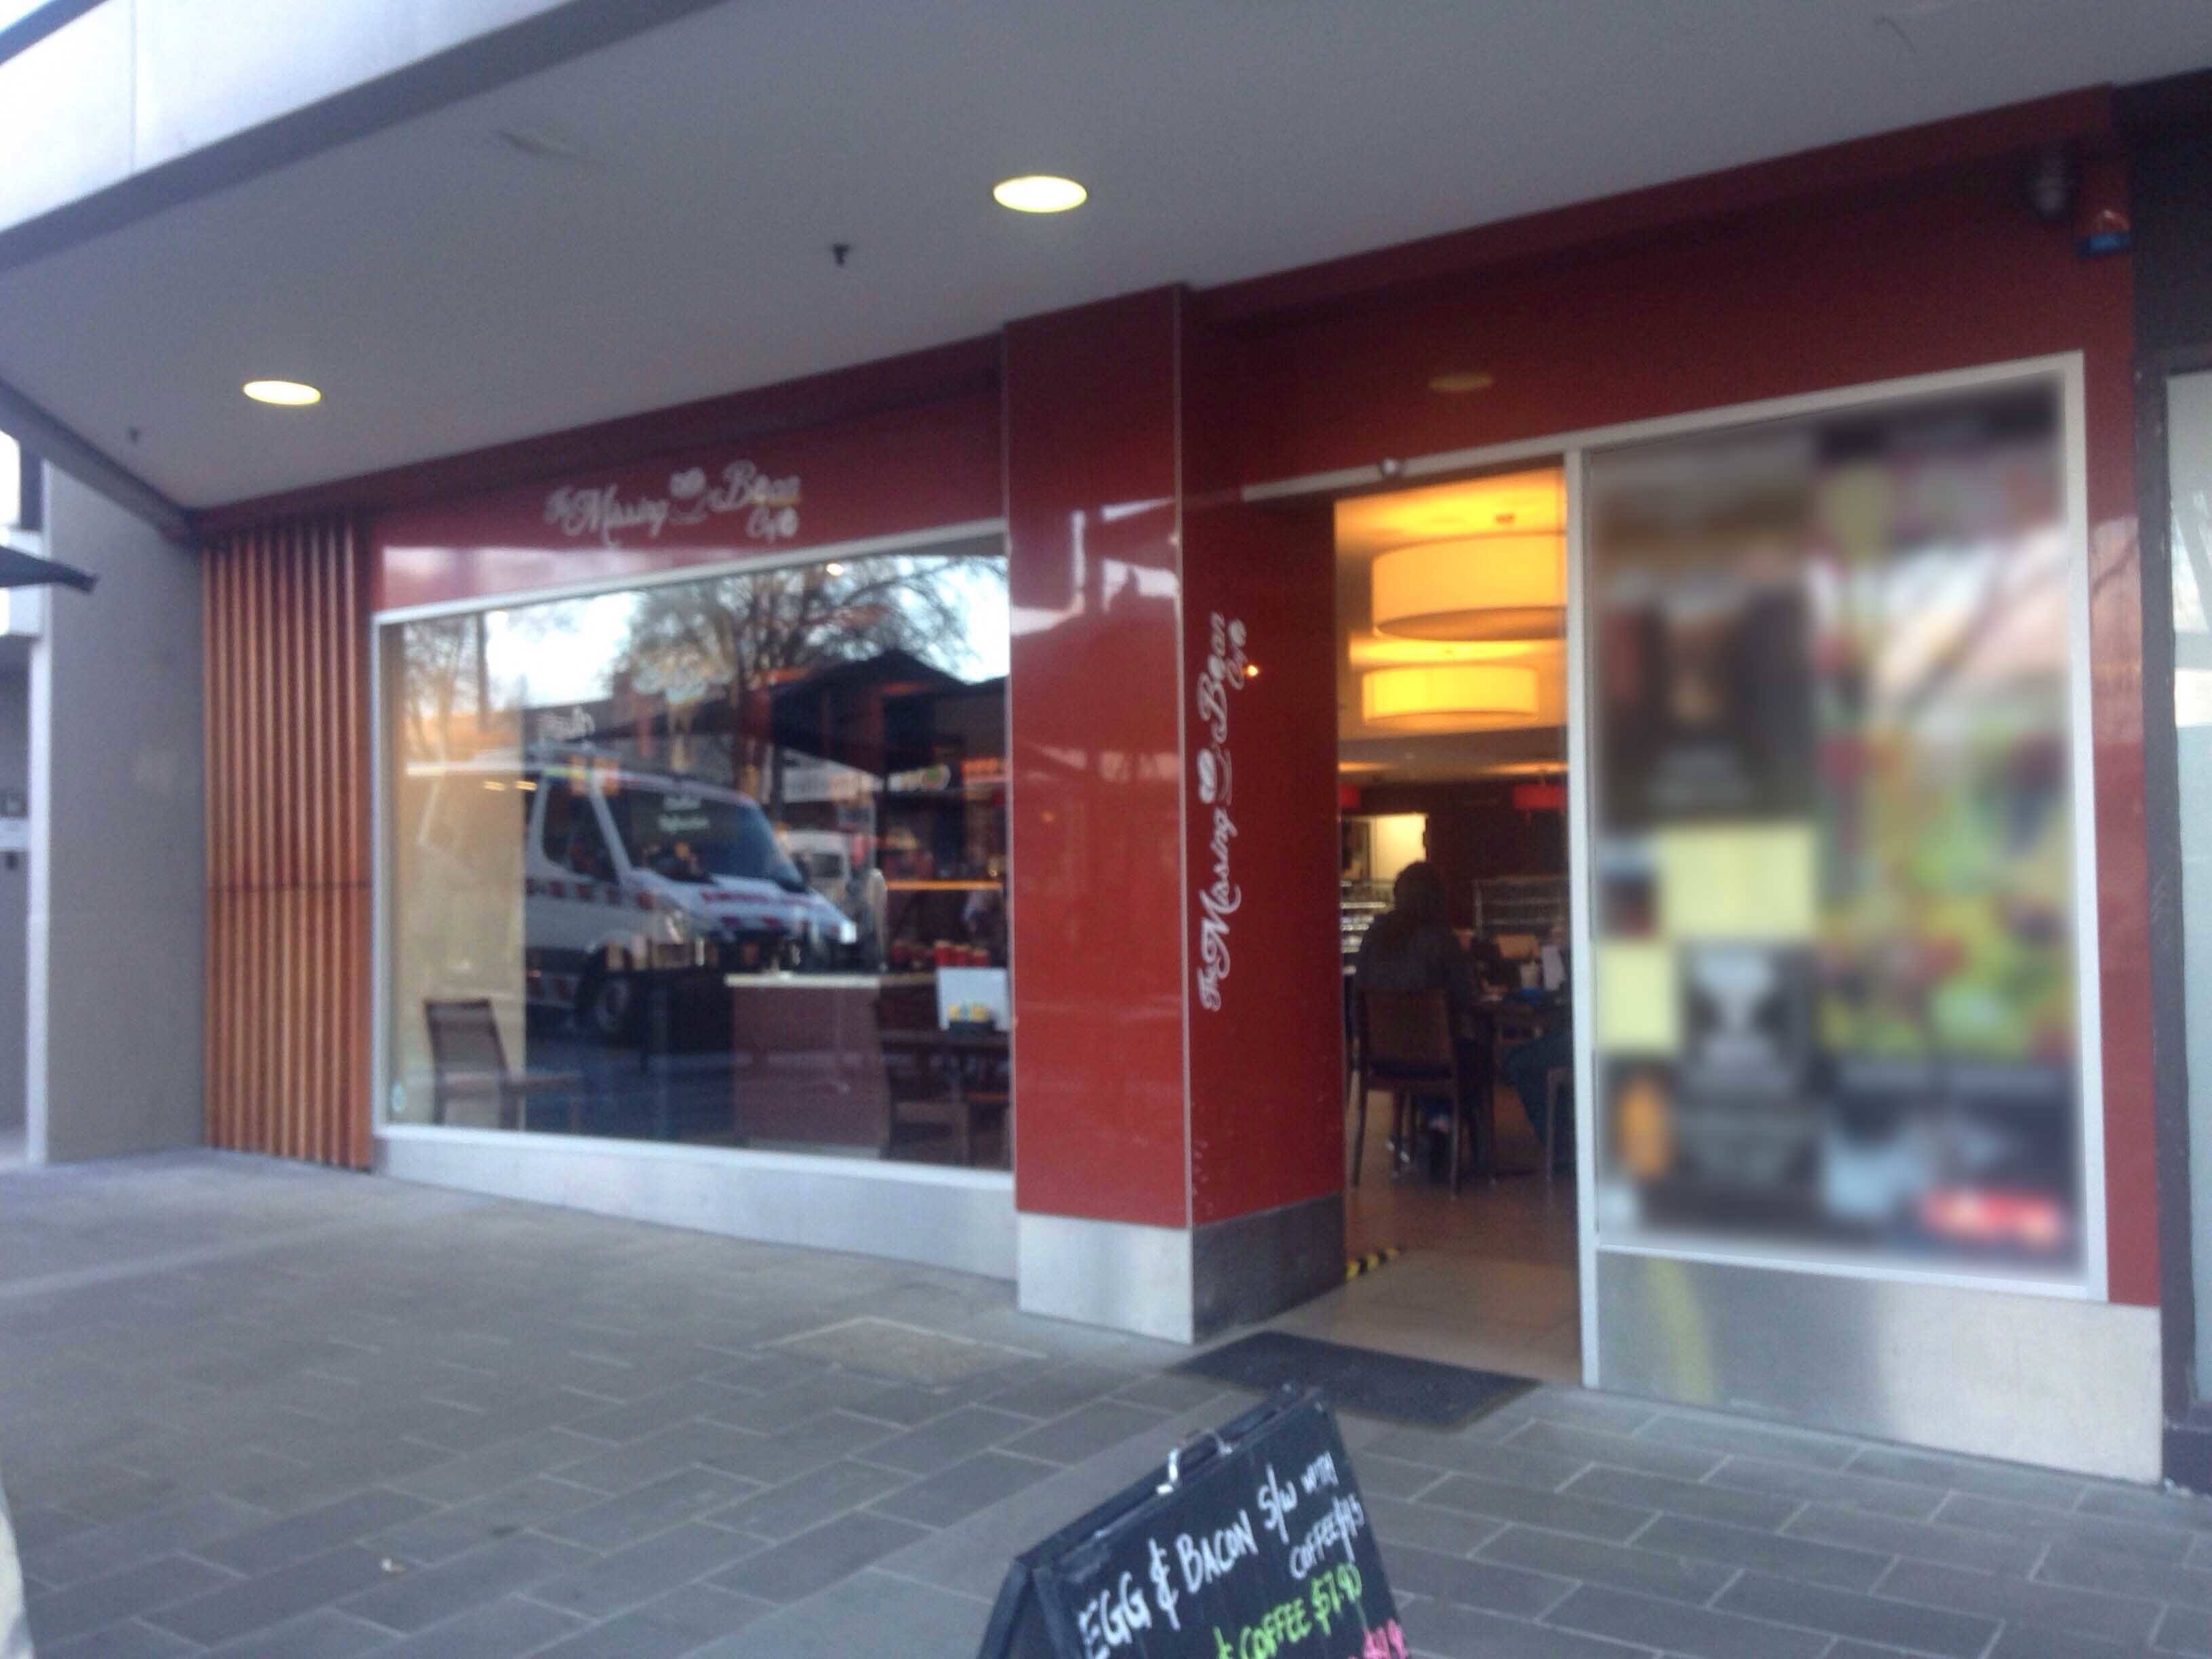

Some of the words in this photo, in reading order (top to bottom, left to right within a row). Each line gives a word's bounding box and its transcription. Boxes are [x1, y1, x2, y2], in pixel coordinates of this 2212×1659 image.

[1196, 611, 1228, 744] Bean
[1200, 807, 1242, 979] Missing
[1078, 1571, 1152, 1659] EGG
[1174, 1508, 1259, 1594] BACON
